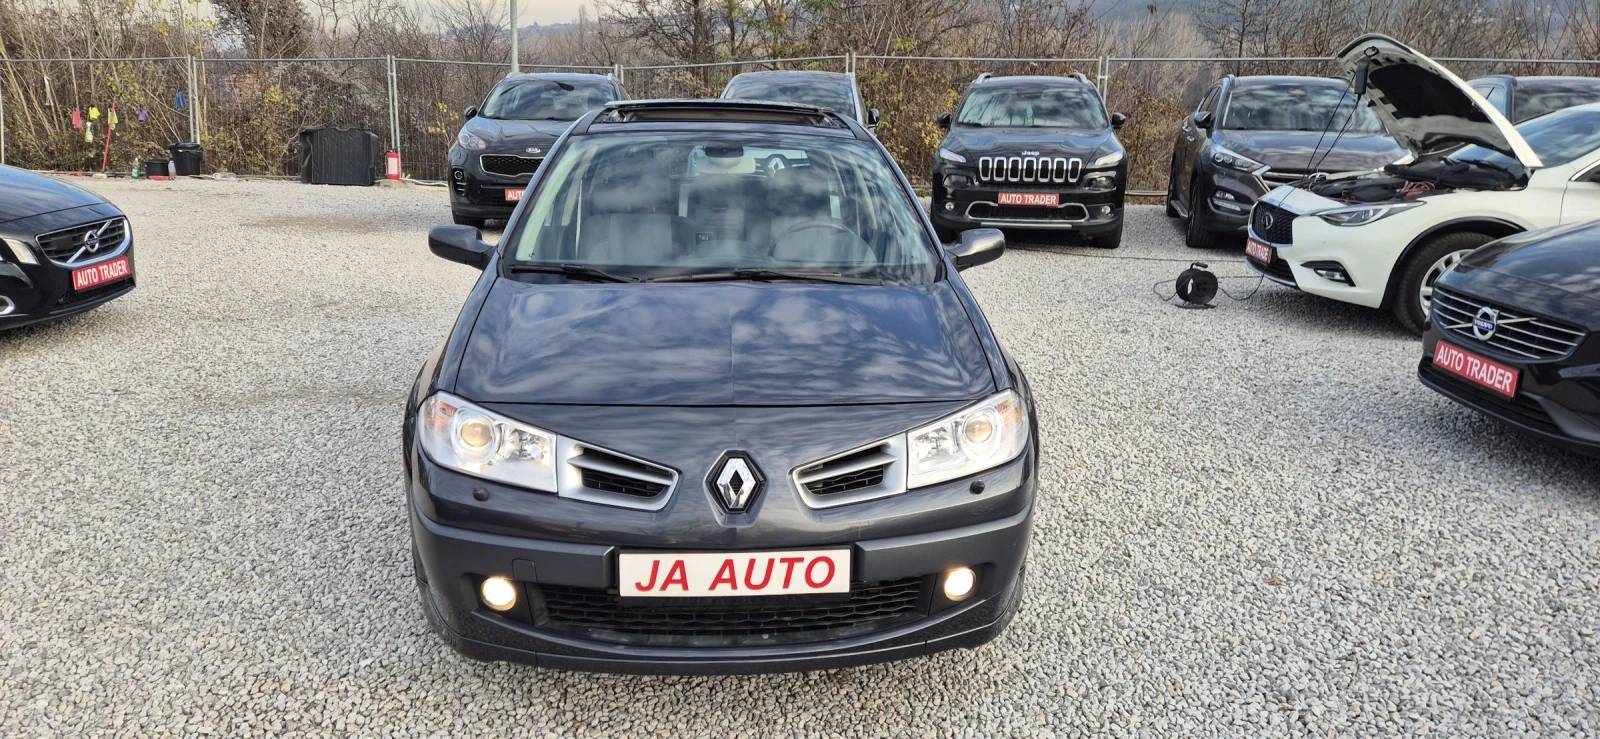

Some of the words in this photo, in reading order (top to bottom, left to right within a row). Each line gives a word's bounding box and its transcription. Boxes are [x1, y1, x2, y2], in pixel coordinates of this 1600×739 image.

[1000, 193, 1022, 203] AUTO
[1024, 194, 1057, 205] TRADER
[77, 267, 99, 287] AUTO
[99, 259, 128, 280] TRADER
[1436, 345, 1465, 371] AUTO
[1466, 356, 1513, 393] TRADER
[634, 559, 690, 592] JA
[707, 555, 836, 591] AUTO
